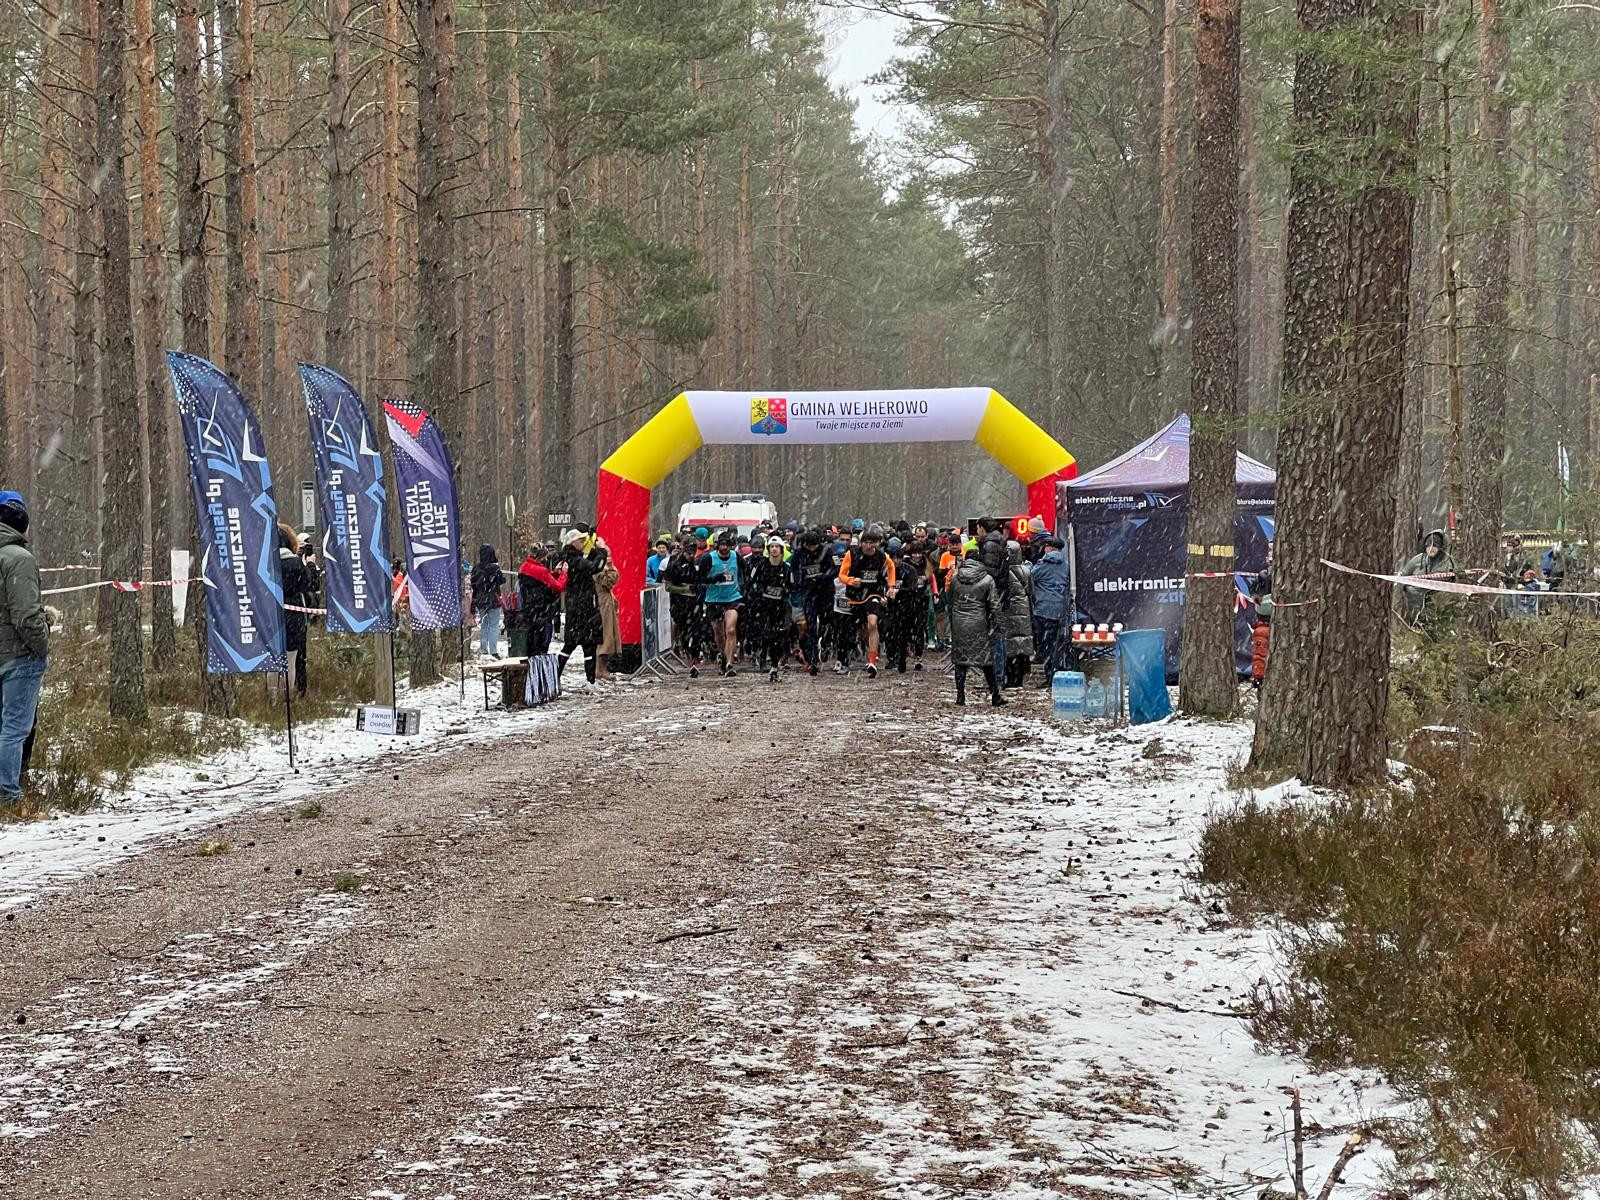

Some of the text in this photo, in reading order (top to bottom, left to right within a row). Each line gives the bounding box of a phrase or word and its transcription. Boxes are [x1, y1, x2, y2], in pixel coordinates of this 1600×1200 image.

[791, 400, 928, 416] GMINA WEJHEROWO
[816, 419, 904, 430] Twoje miejsce na Ziemi
[1075, 495, 1134, 504] elektroniczne
[1107, 500, 1147, 510] zapisy.pl
